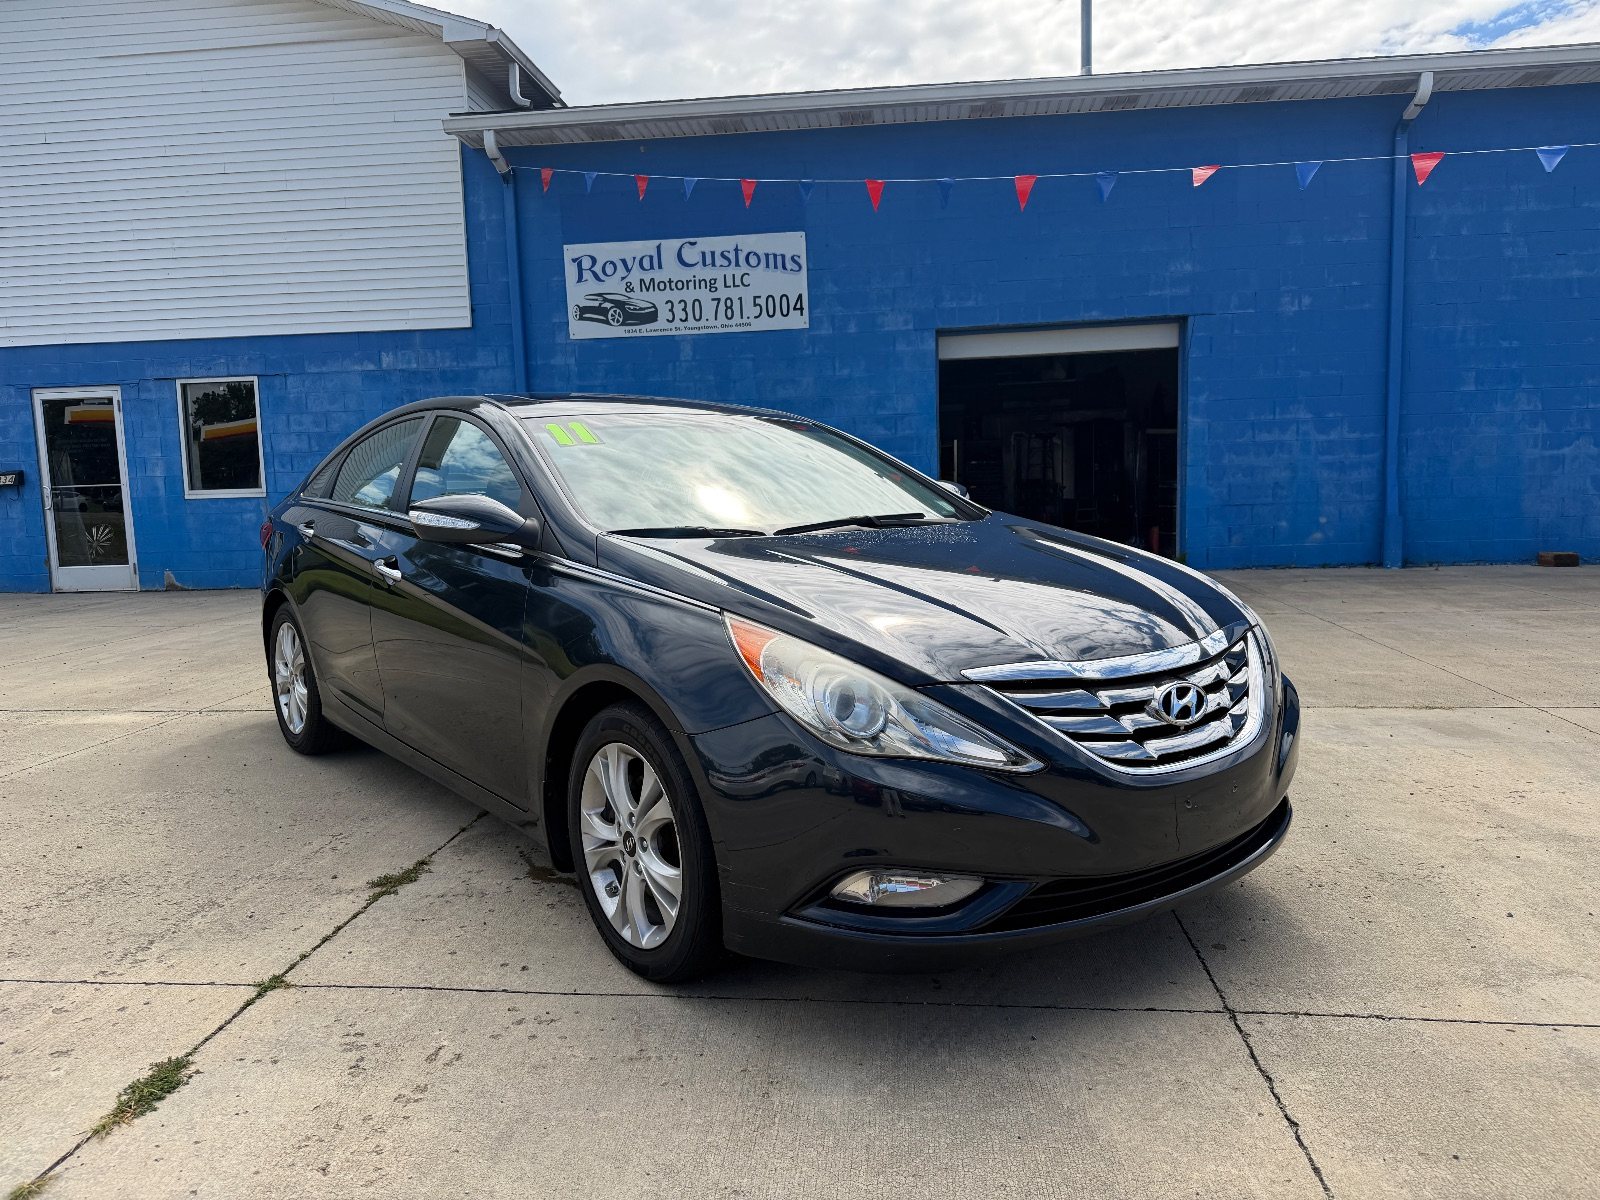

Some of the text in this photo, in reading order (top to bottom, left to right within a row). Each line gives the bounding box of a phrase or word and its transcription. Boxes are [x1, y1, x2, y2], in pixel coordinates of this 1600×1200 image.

[571, 240, 803, 284] Royal Customs
[624, 272, 751, 293] & Motoring LLC
[664, 293, 805, 324] 330.781.5004
[545, 421, 599, 446] 11
